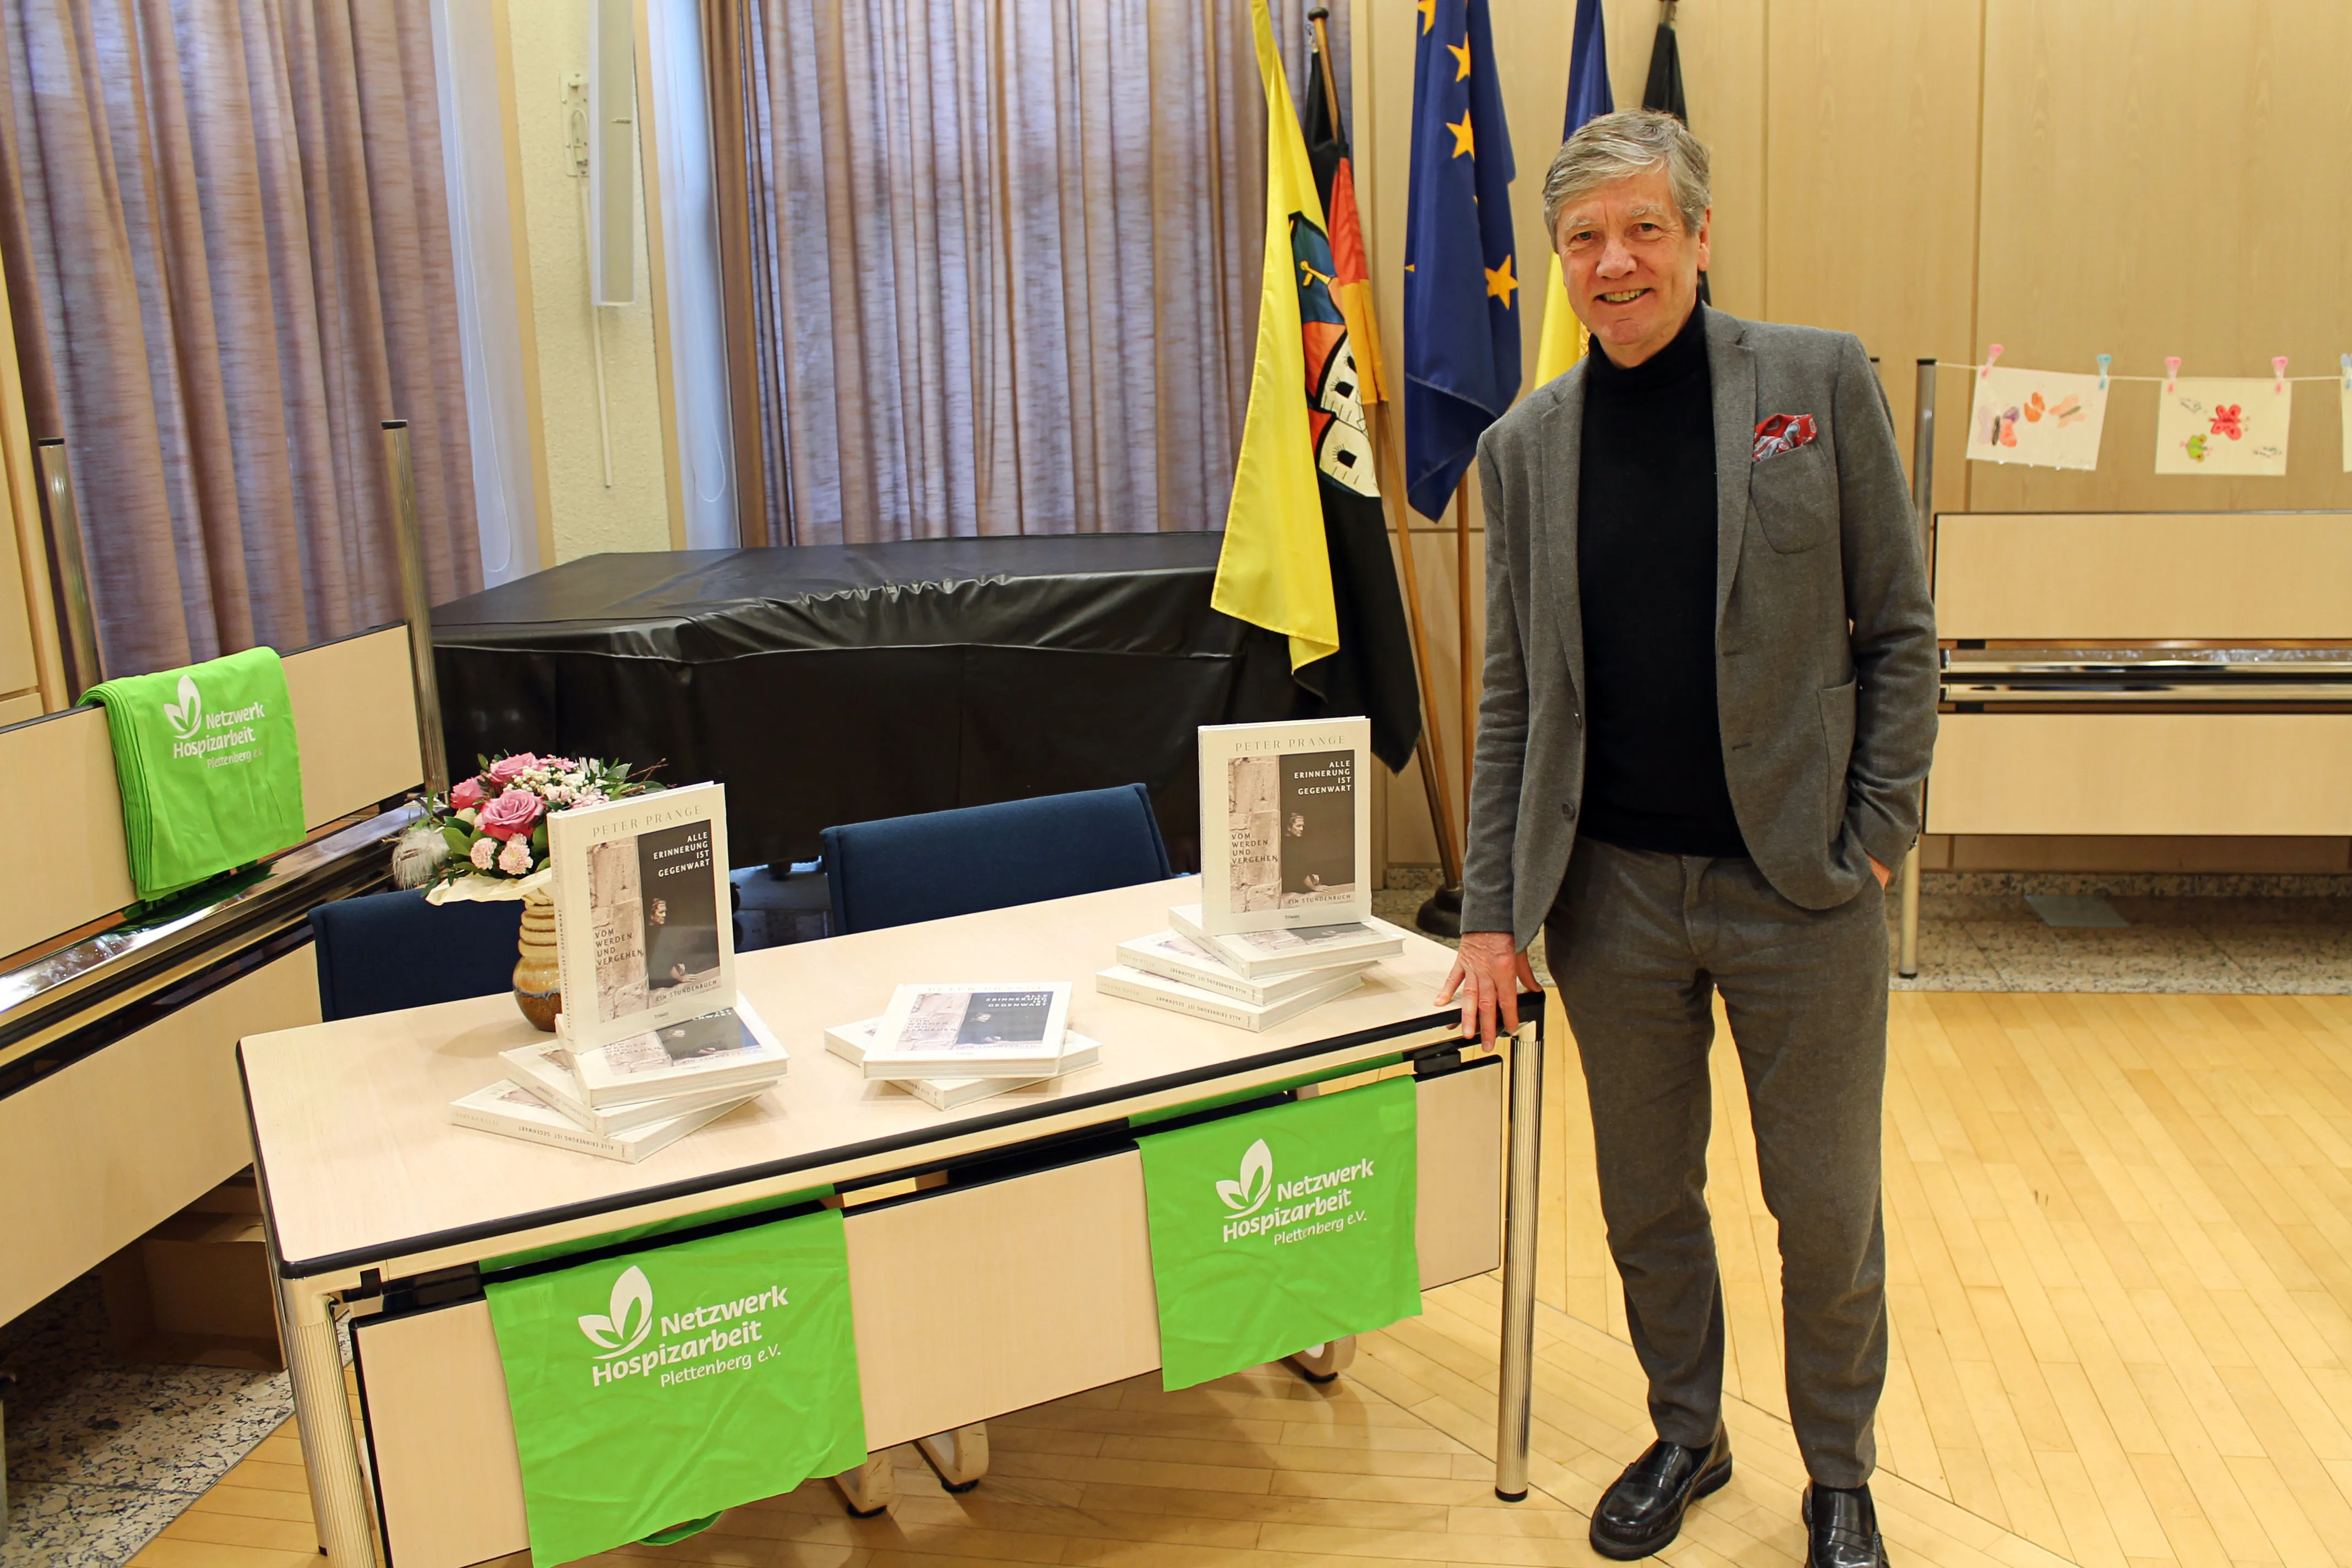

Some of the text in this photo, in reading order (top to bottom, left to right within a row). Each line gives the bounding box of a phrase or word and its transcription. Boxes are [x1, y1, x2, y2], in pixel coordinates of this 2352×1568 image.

[206, 701, 265, 729] Netzwerk
[173, 726, 255, 759] Hospizarbeit
[1235, 736, 1346, 752] PETER PRANGE
[207, 750, 252, 768] Plettenberg
[1329, 760, 1351, 768] ALLE
[1294, 768, 1351, 779] ERINNERUNG
[1298, 785, 1352, 795] GEGENWART
[593, 805, 701, 837] PETER PRANGE
[687, 831, 708, 842] ALLE
[1232, 839, 1268, 848] WERDEN
[653, 841, 708, 860] ERINNERUNG
[696, 850, 710, 859] IST
[658, 858, 710, 877] GEGENWART
[1232, 855, 1278, 864] VERGEHEN
[1302, 894, 1351, 903] STUNDENBUCH
[595, 928, 614, 939] VOM
[596, 933, 632, 948] WERDEN
[597, 947, 616, 957] UND
[597, 949, 644, 966] VERGEHEN
[669, 979, 717, 998] STUNDENBUCH
[1156, 995, 1184, 1007] GEGENWART
[518, 1125, 550, 1137] GEGENWART
[564, 1135, 599, 1147] ERINNERUNG
[1277, 1158, 1374, 1202] Netzwerk
[1223, 1188, 1352, 1243] Hospizarbeit
[1274, 1210, 1367, 1245] Plettenberg e.V.
[661, 1285, 788, 1337] Netzwerk
[592, 1320, 763, 1387] Hospizarbeit
[661, 1343, 781, 1387] Plettenberg e.V.
